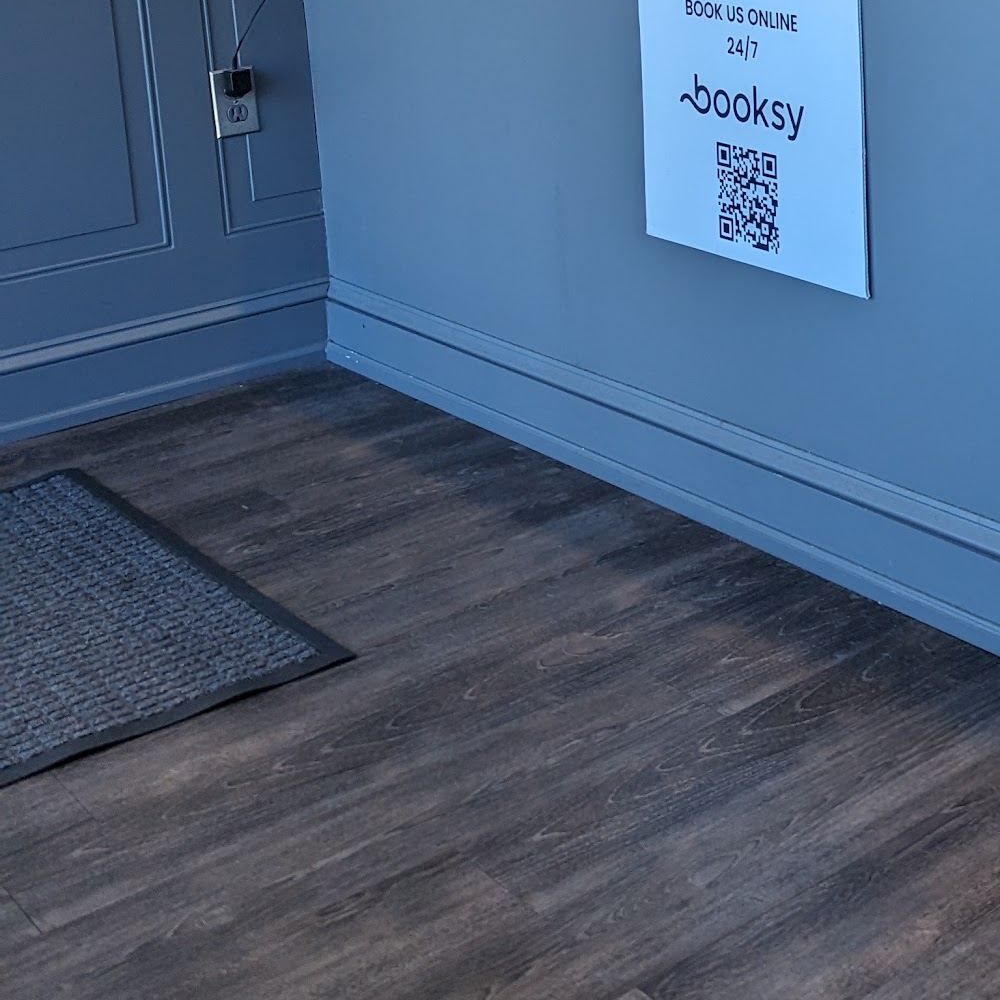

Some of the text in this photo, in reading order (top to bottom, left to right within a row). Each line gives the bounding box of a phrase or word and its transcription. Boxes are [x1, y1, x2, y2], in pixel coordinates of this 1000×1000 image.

[685, 0, 798, 32] BOOK US ONLINE
[727, 35, 758, 61] 24/7
[680, 73, 805, 141] booksy
